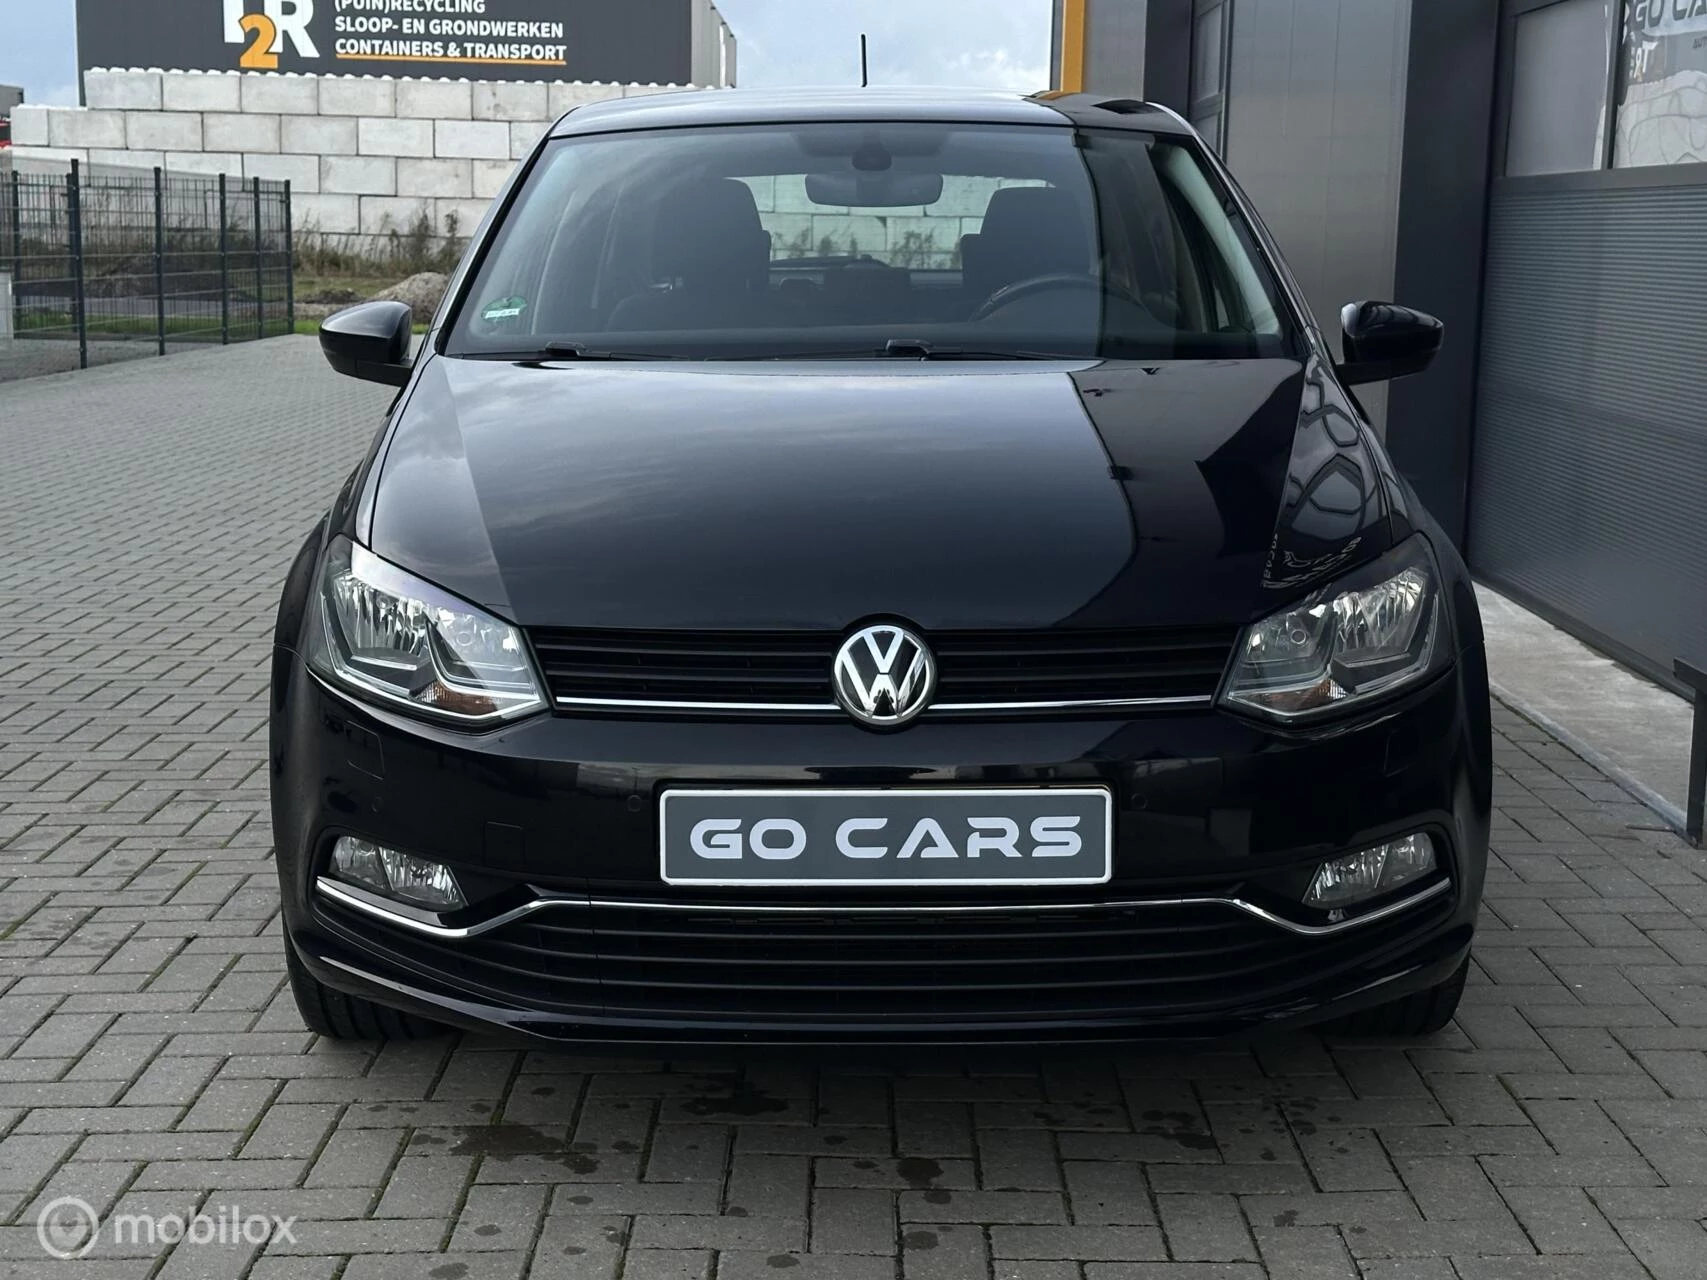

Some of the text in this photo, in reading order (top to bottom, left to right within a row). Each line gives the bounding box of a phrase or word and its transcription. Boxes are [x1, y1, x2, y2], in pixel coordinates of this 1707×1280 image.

[334, 16, 564, 38] SLOOP- EN GRONDWERKEN
[335, 38, 567, 60] CONTAINERS & TRANSPORT
[690, 816, 1082, 860] GO CARS
